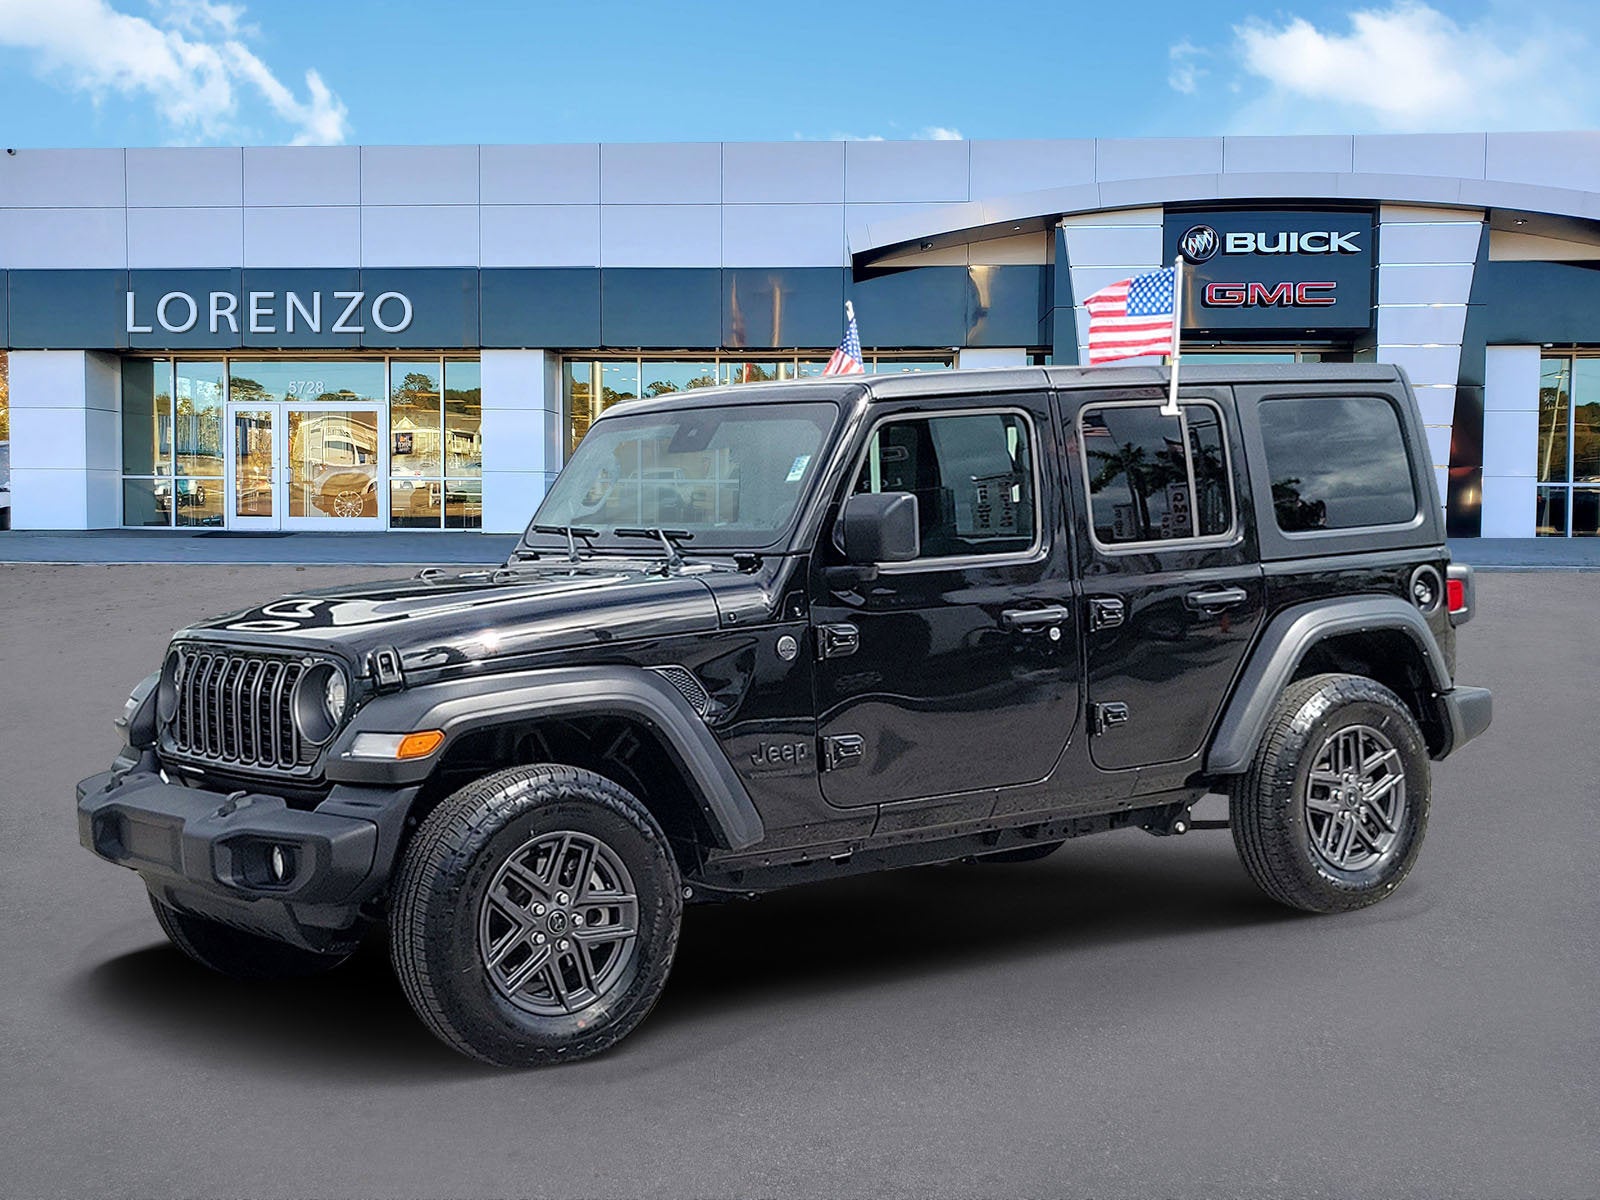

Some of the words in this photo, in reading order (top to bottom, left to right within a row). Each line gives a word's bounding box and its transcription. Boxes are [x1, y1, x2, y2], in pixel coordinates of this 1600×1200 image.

[1225, 231, 1362, 253] BUICK
[1204, 281, 1338, 306] GMC
[125, 290, 414, 334] LORENZO
[287, 380, 325, 395] 5728
[750, 741, 808, 767] Jeep
